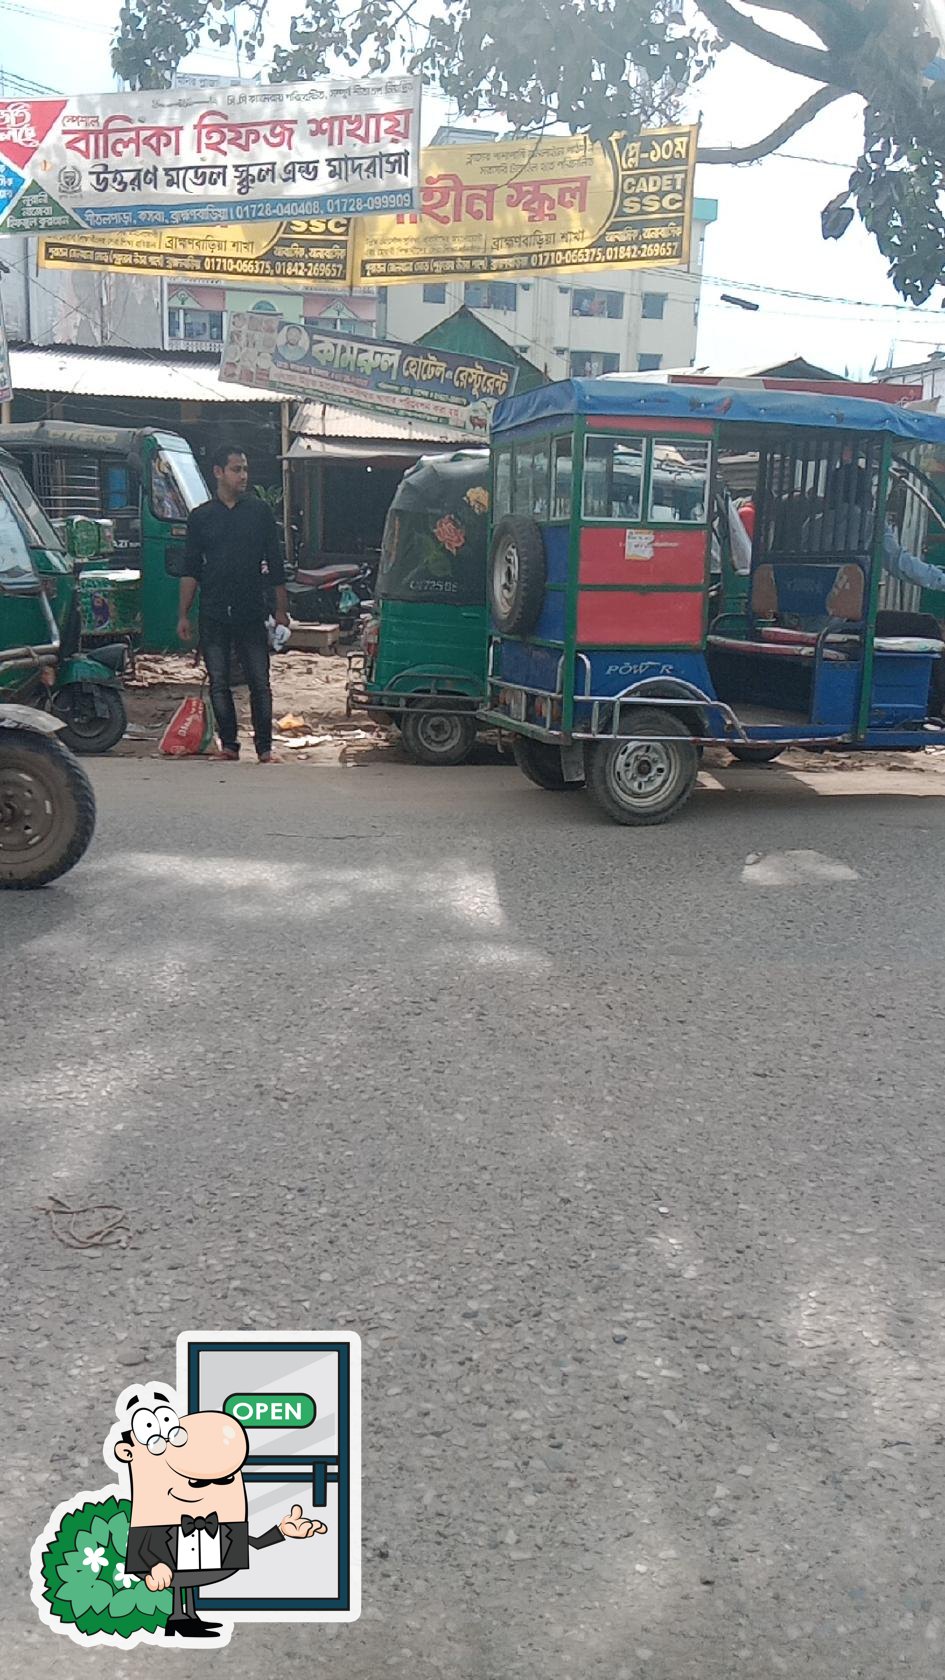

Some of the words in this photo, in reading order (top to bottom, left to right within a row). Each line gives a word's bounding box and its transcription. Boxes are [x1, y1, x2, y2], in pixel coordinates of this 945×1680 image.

[61, 115, 183, 160] বালিকা
[193, 109, 299, 156] হিফজ
[307, 109, 413, 145] শাখায়
[89, 163, 158, 193] উত্তরণ
[163, 163, 227, 193] মডেল
[233, 161, 276, 196] স্কুল
[280, 159, 319, 182] এন্ড
[326, 148, 409, 184] মাদরাসা
[623, 173, 685, 194] CADET
[328, 193, 411, 212] 01728-099909
[507, 175, 592, 222] স্কুল
[622, 192, 683, 214] SSC
[290, 218, 348, 234] SSC
[560, 229, 585, 244] শাখা
[311, 334, 402, 380] কামরুল
[403, 352, 448, 383] হোটেল
[453, 361, 509, 399] রেস্টুরেন্ট
[606, 662, 674, 675] POWR
